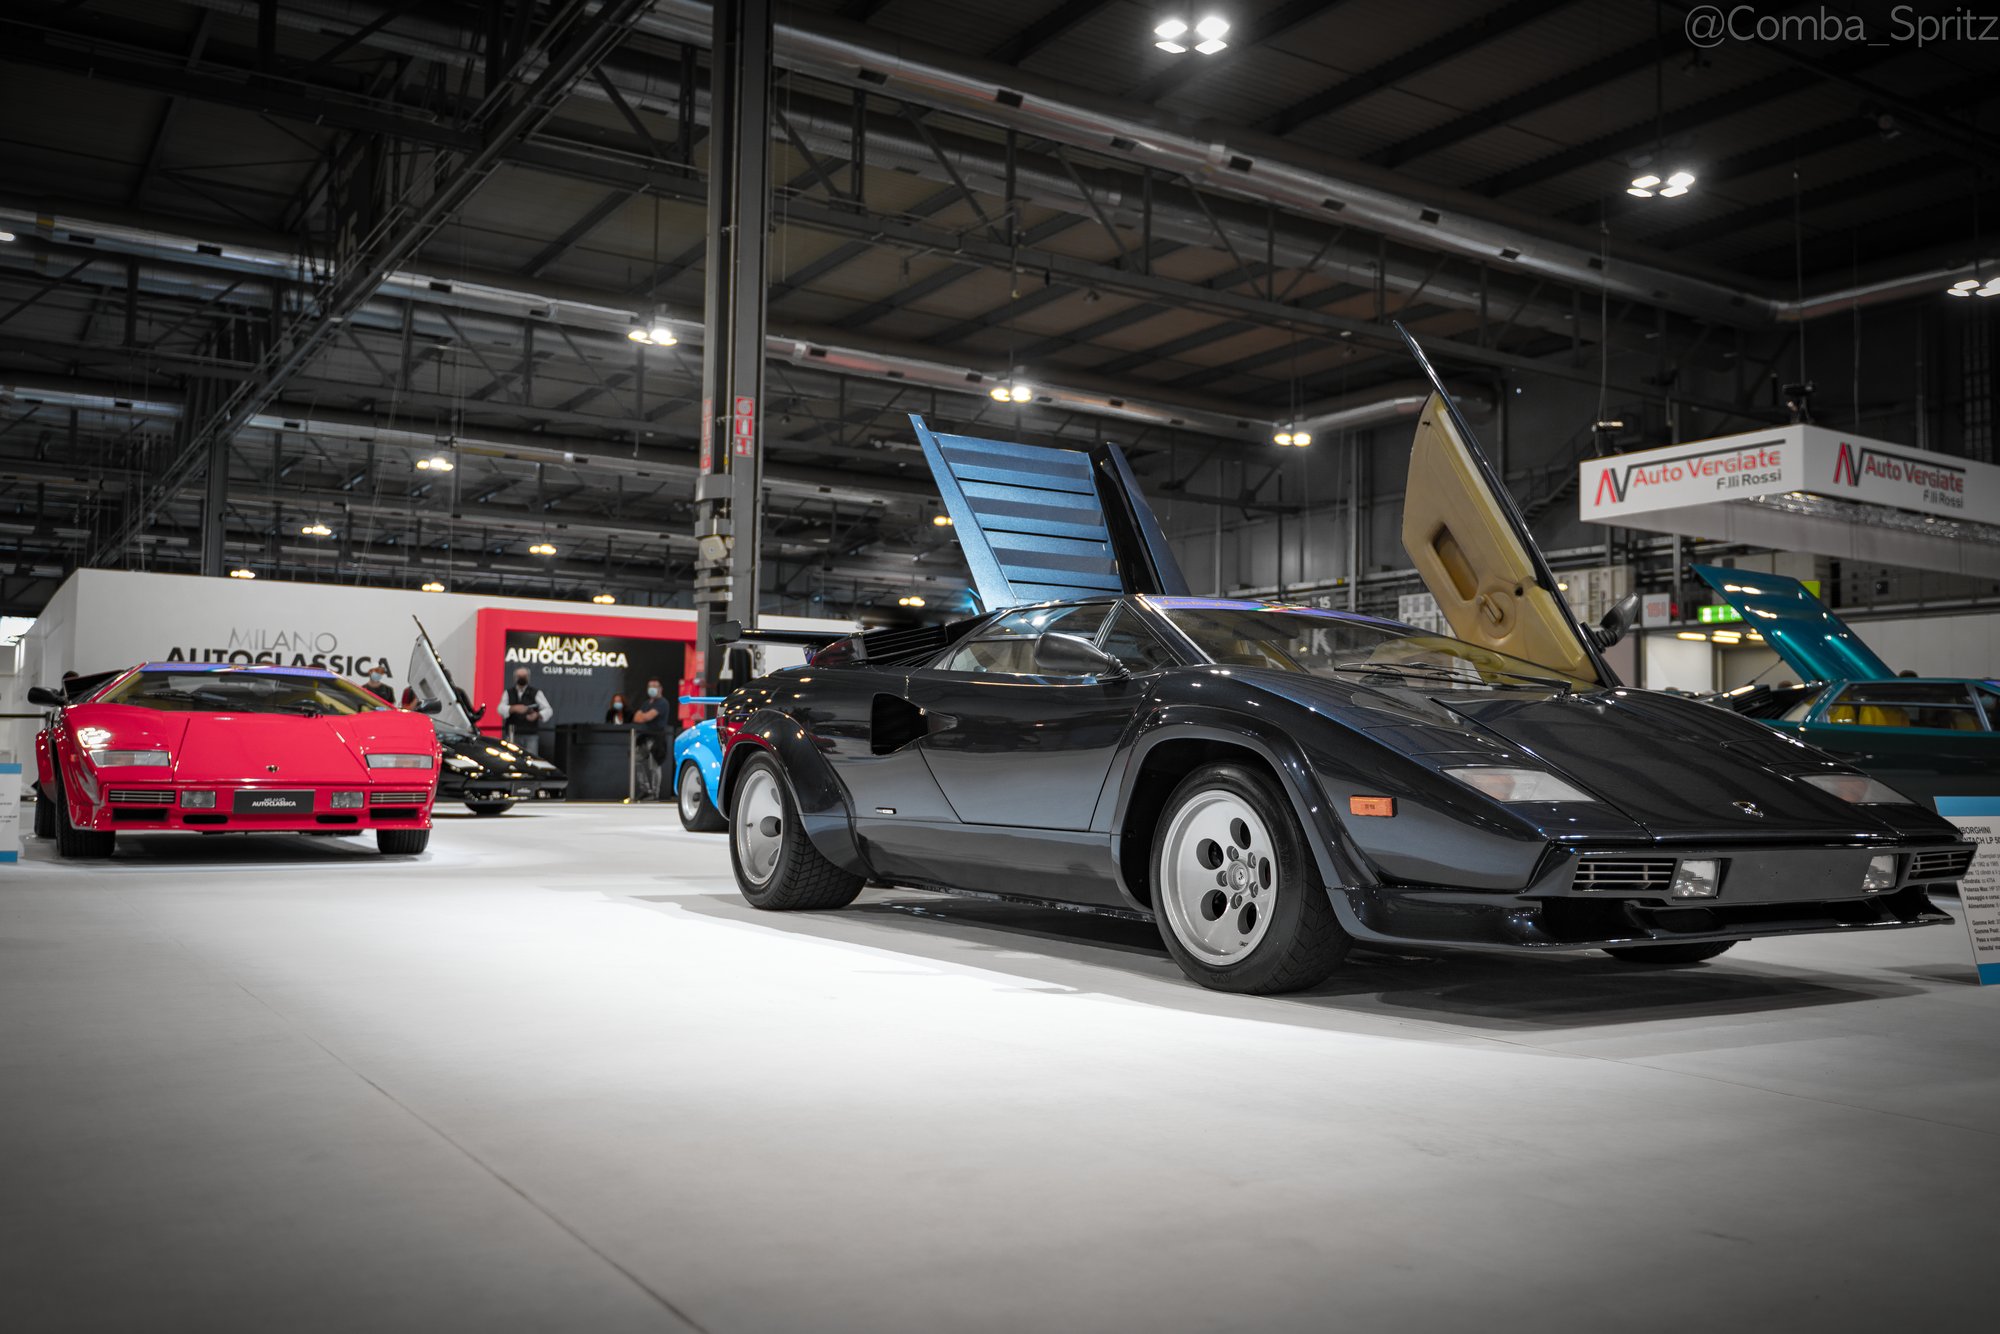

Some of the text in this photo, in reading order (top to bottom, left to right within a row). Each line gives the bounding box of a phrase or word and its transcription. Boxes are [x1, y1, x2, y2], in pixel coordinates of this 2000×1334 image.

[1633, 464, 1683, 487] Auto
[1865, 454, 1902, 481] Auto
[1741, 469, 1782, 486] Rossi
[1939, 491, 1963, 509] Rossi
[228, 627, 337, 654] MILANO
[538, 635, 599, 652] MILANO
[505, 647, 629, 668] AUTOCLASSICA
[542, 666, 593, 676] CLUB HOUSE
